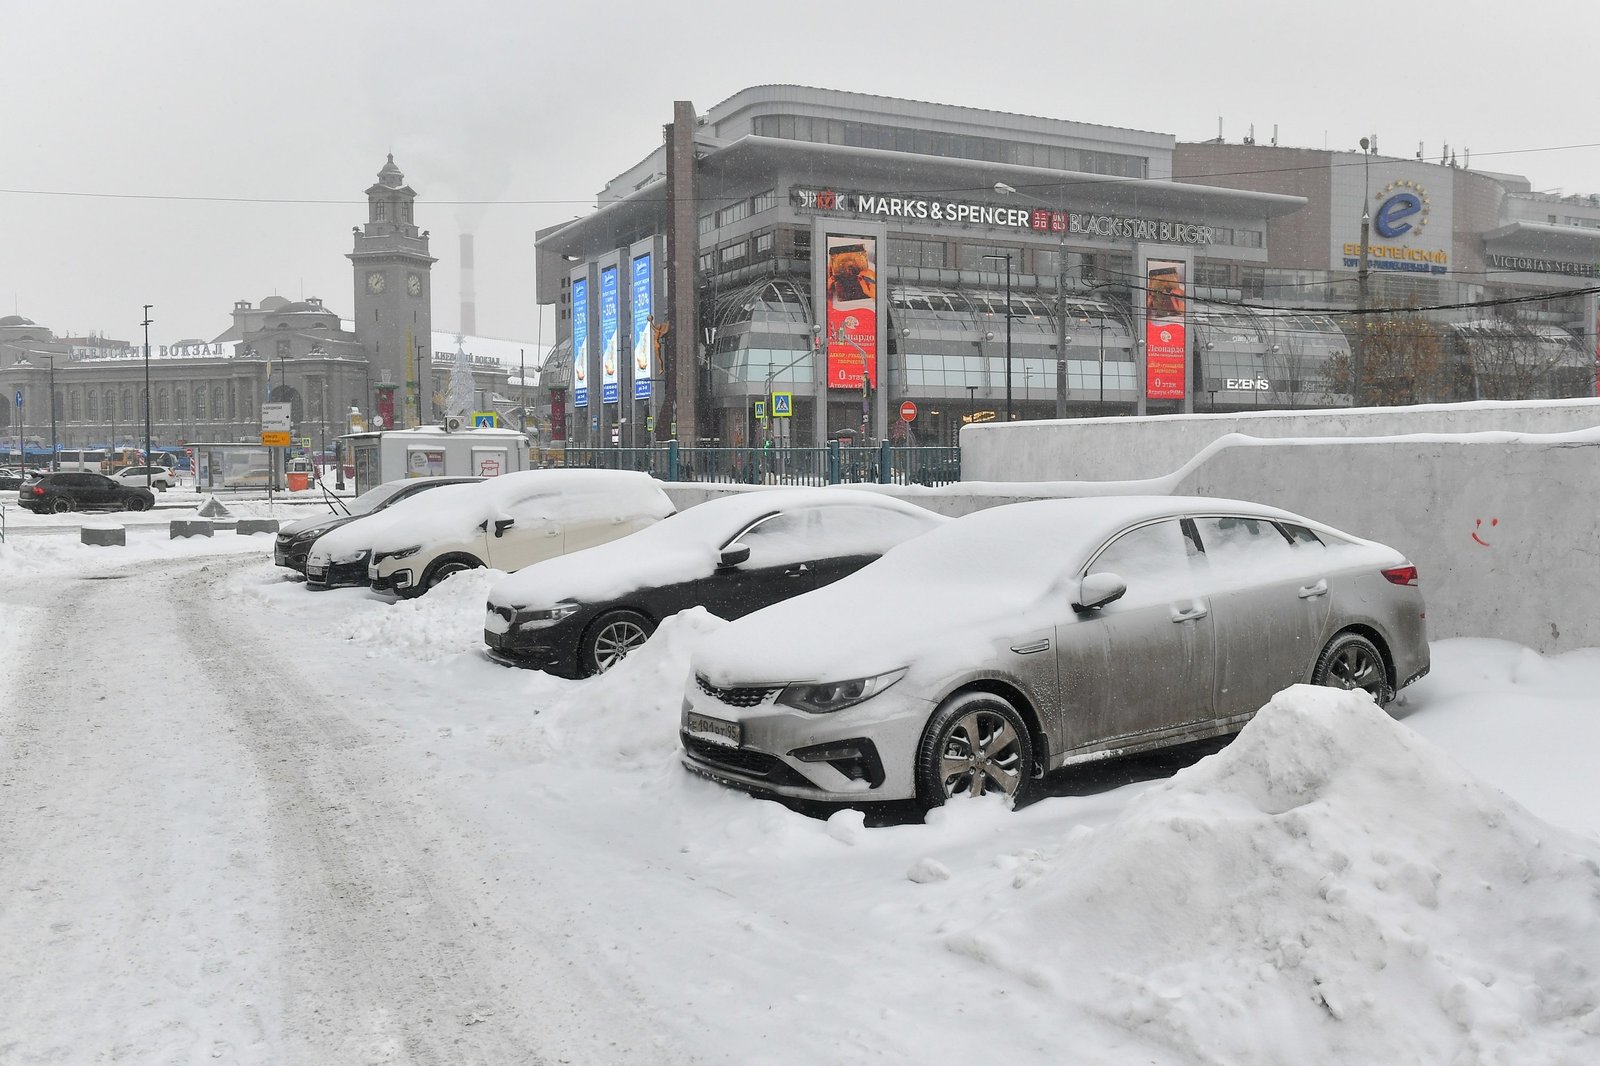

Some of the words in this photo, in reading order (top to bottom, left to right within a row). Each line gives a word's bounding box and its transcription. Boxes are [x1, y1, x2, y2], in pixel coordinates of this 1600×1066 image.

[858, 195, 928, 220] MARKS
[931, 202, 943, 220] &
[946, 203, 1030, 228] SPENCER
[1052, 214, 1065, 222] UNI
[1069, 213, 1119, 236] BLACK
[1124, 218, 1158, 239] STAR
[1159, 222, 1214, 245] BURGER
[1555, 261, 1591, 275] SECRET
[159, 343, 223, 357] ВОКЗАЛ
[1147, 345, 1184, 354] Леонардо
[474, 355, 501, 366] ВОКЗАЛ
[838, 369, 846, 380] 0
[1154, 377, 1161, 388] 0
[727, 725, 737, 739] 95
